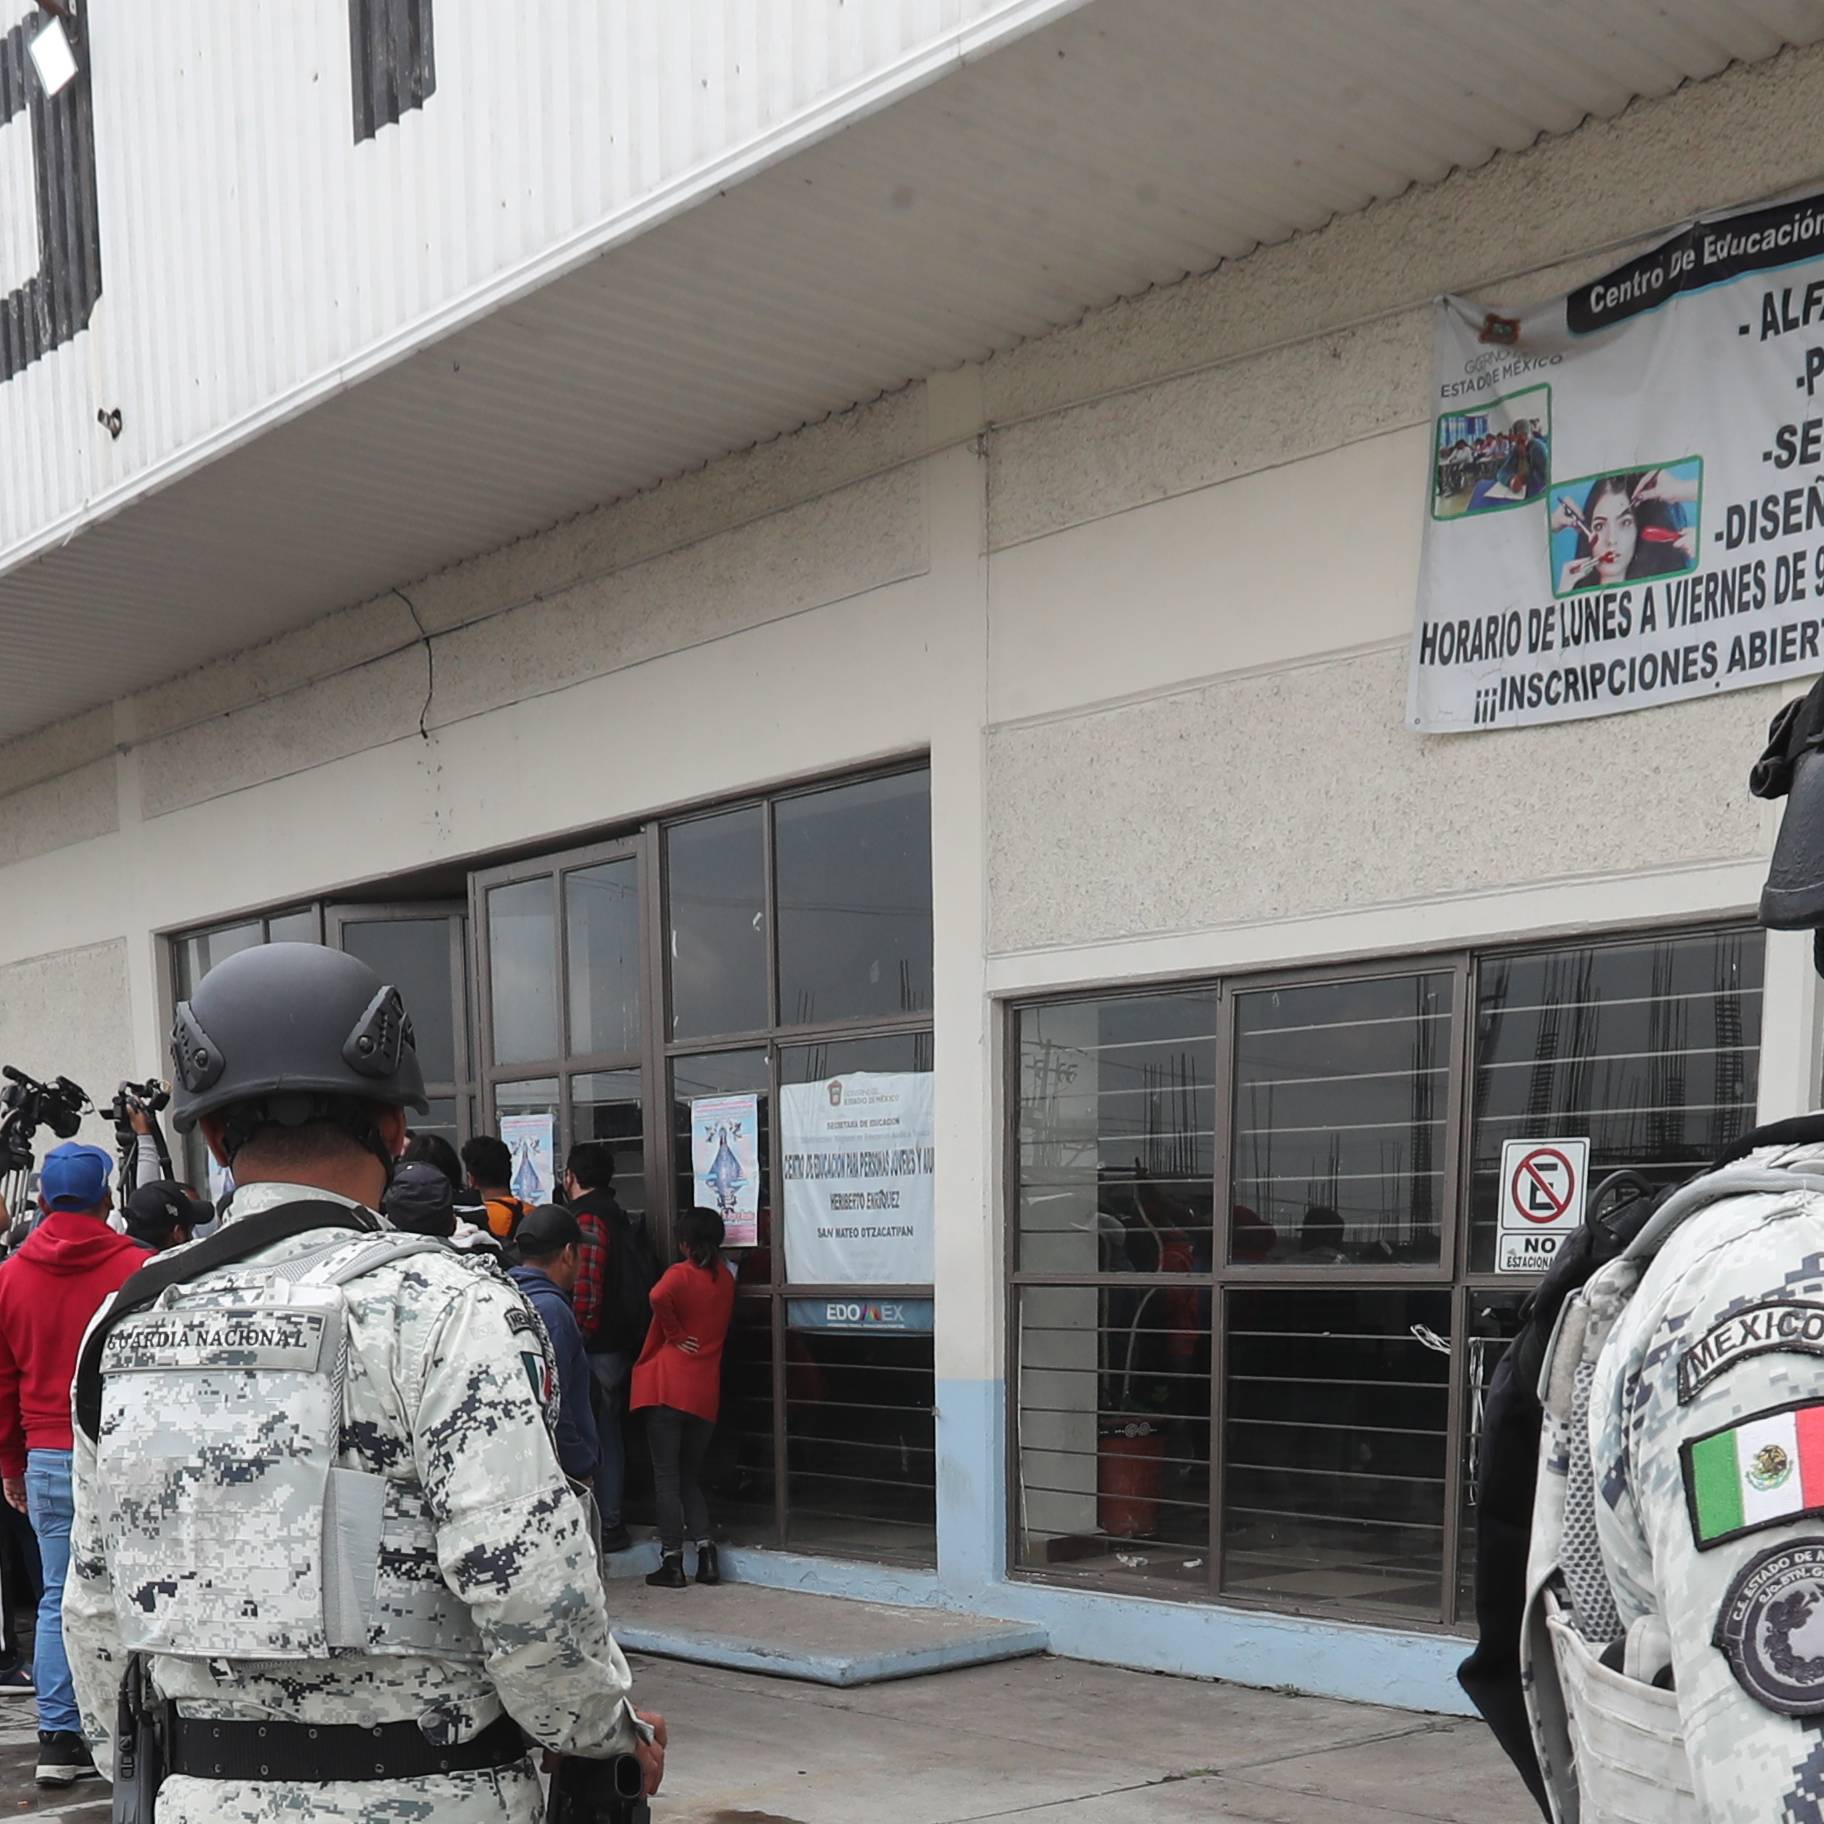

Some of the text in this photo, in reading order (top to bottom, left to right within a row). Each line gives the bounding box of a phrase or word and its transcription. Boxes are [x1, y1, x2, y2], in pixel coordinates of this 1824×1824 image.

[1589, 265, 1664, 315] Centro
[1668, 244, 1695, 280] De
[1419, 609, 1521, 666] HORARIO
[1528, 604, 1556, 655] DE
[1560, 590, 1632, 649] LUNES
[1640, 586, 1657, 635] A
[1666, 559, 1766, 629] VIERNES
[1774, 550, 1808, 606] DE
[817, 1227, 834, 1238] SAN
[835, 1227, 859, 1238] MATEO
[1524, 1238, 1557, 1254] NO
[106, 1328, 308, 1351] GUARDIA NACIONAL
[1743, 1557, 1791, 1598] ESTADO
[1794, 1551, 1814, 1563] DE
